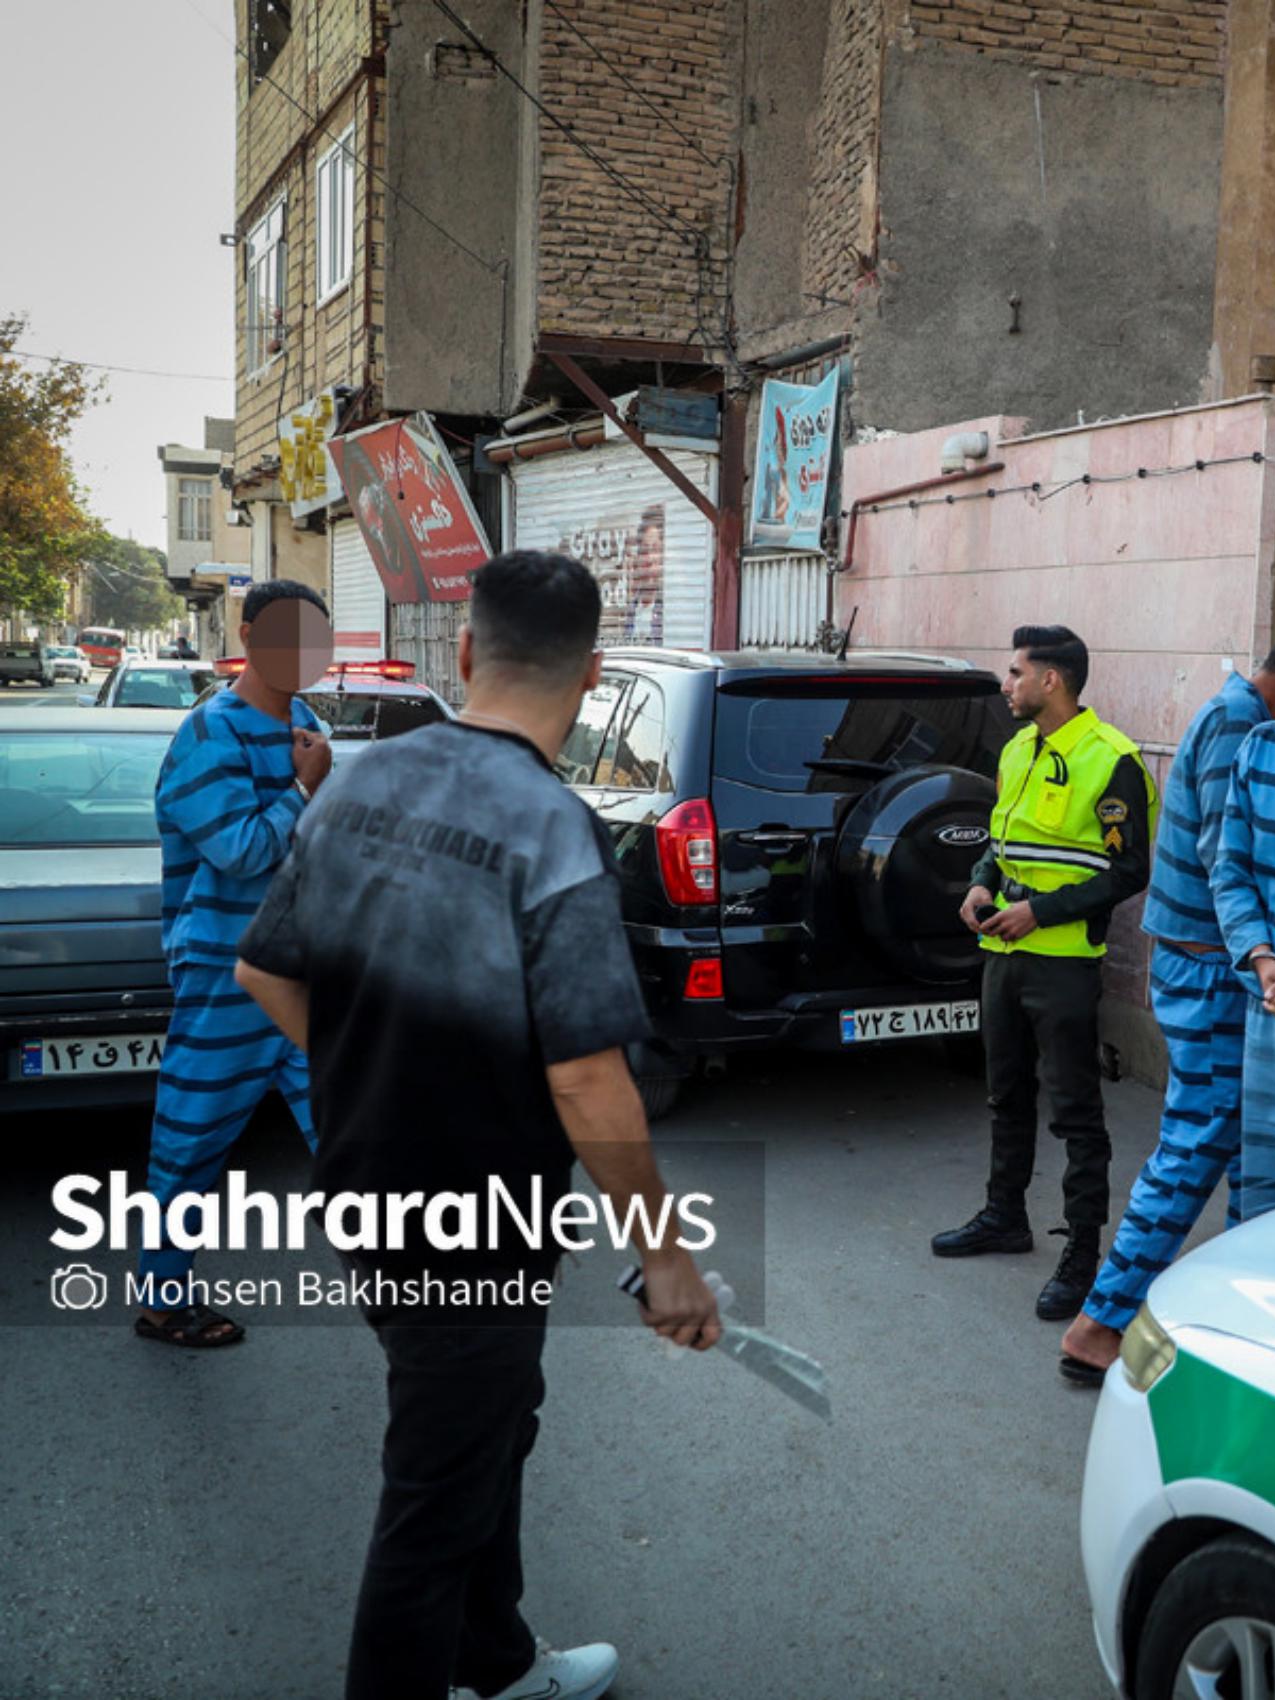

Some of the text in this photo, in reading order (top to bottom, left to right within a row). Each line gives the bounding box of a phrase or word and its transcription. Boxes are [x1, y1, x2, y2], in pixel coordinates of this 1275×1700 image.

[888, 1010, 906, 1033] ج
[912, 1006, 949, 1032] ۱۸۹
[48, 1039, 163, 1071] ۱۴ ق ۴۸
